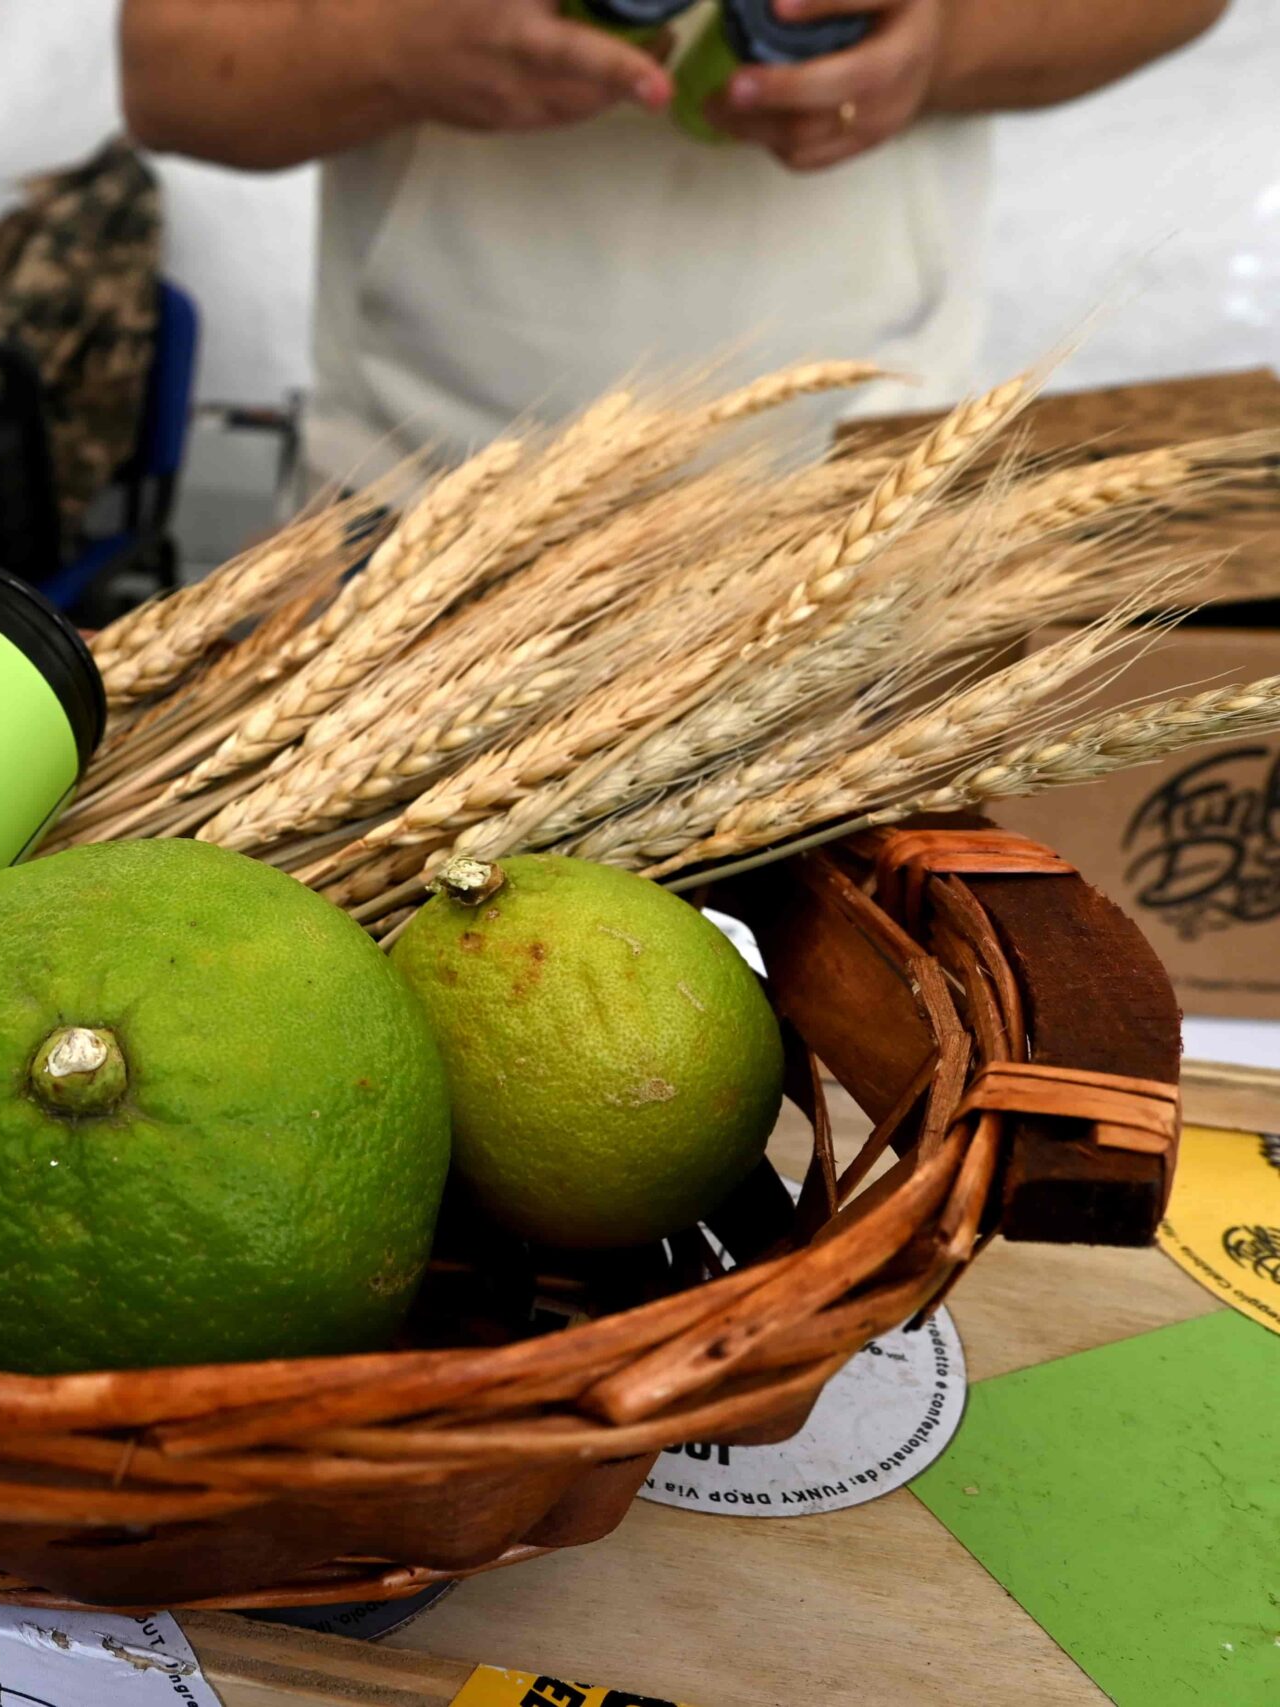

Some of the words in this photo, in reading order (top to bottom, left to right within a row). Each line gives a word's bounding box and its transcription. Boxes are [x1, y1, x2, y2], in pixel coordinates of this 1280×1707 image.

[879, 1393, 946, 1472] confezionato
[848, 1468, 879, 1487] da:
[665, 1482, 700, 1500] Via
[708, 1489, 772, 1505] DROP
[780, 1481, 849, 1505] FUNKY
